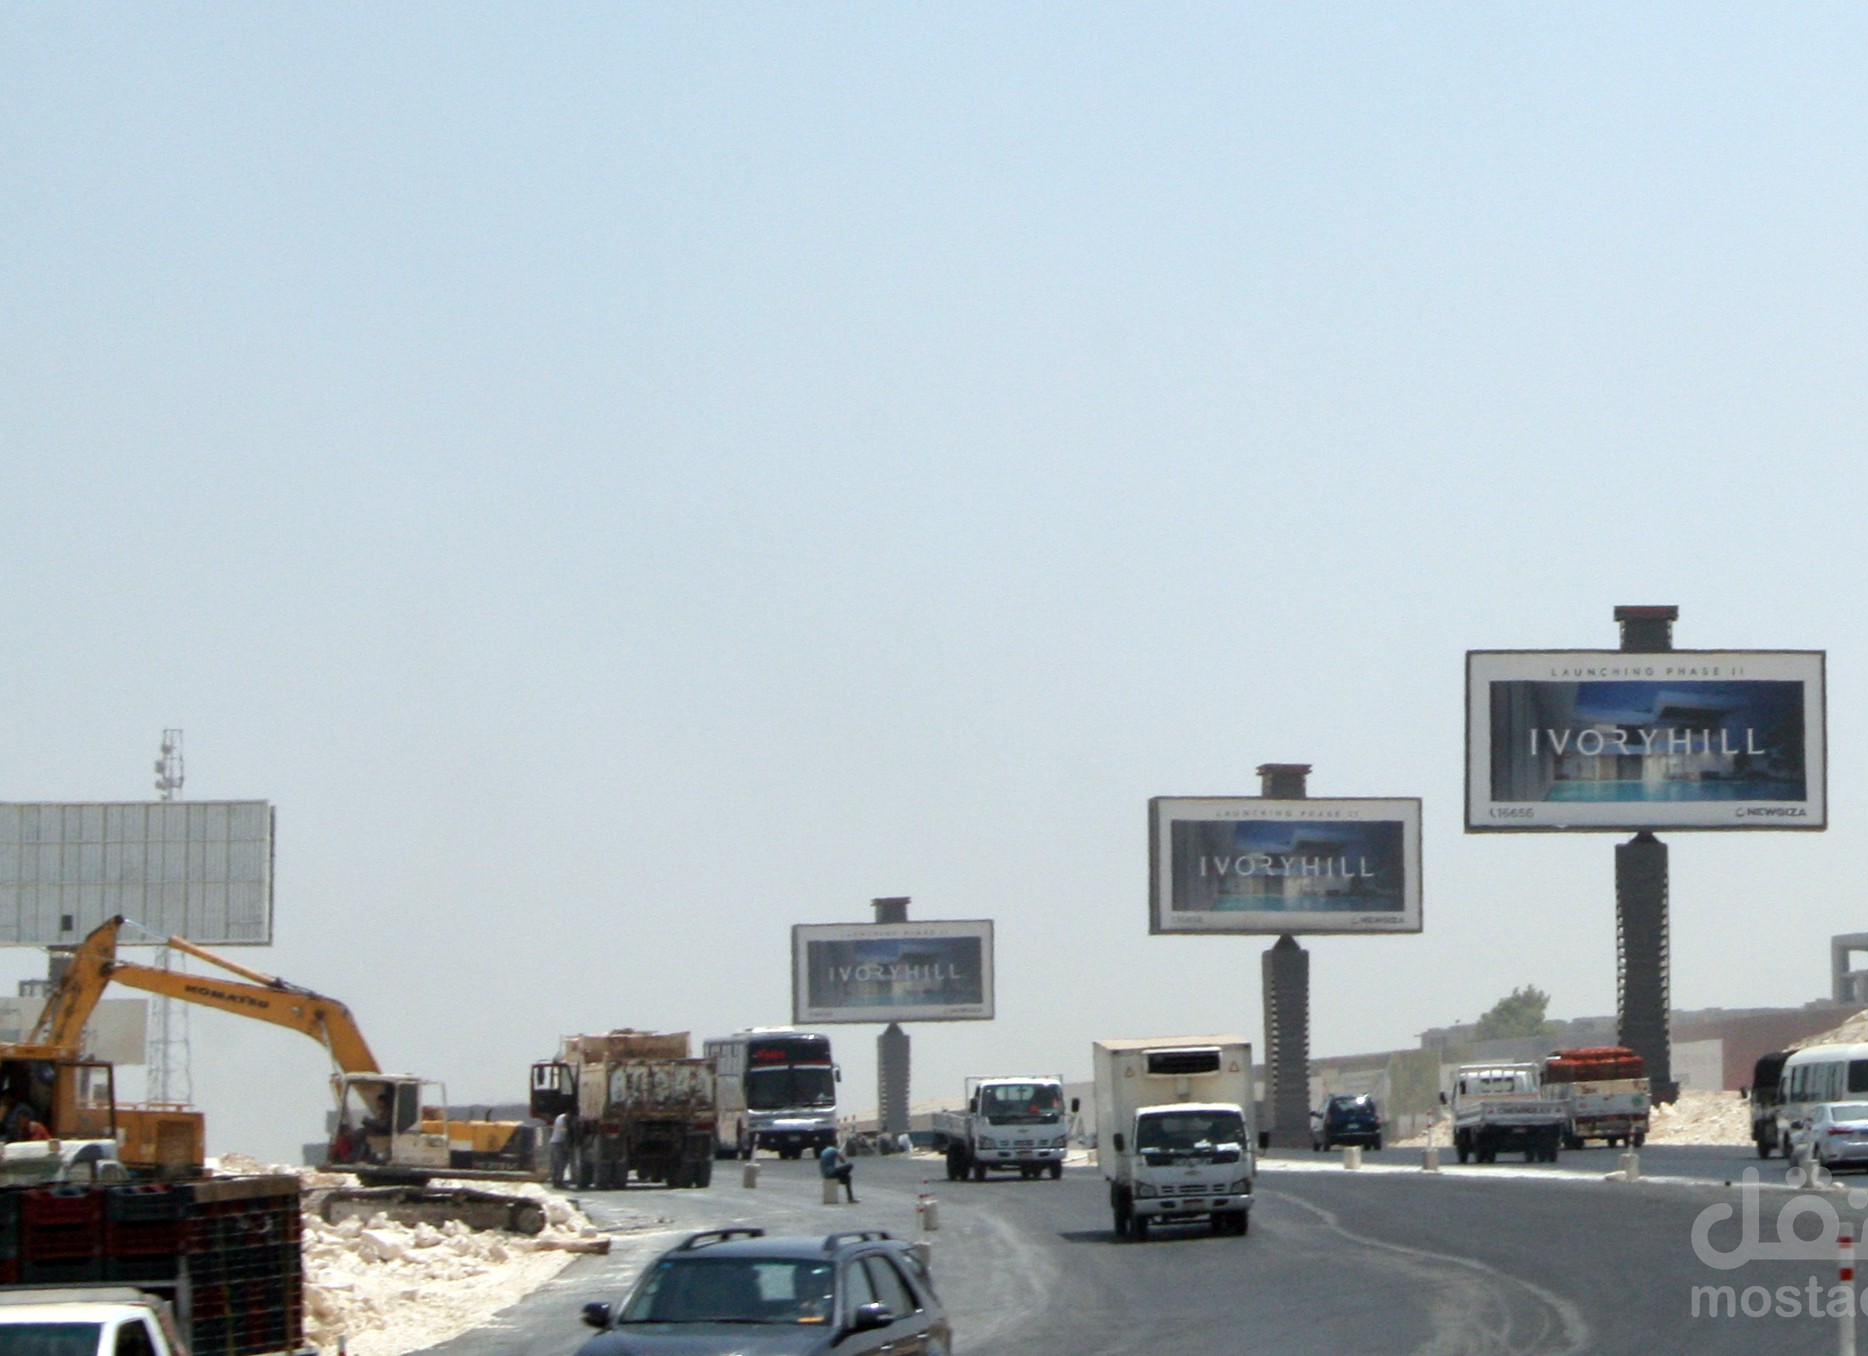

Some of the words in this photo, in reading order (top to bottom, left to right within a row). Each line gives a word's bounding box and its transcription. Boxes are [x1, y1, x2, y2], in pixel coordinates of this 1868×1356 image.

[1550, 667, 1655, 677] LAUNCHING
[1666, 666, 1720, 676] PHASE
[1529, 727, 1766, 756] IVORYHILL
[1200, 855, 1375, 877] IVORYHILL
[828, 963, 962, 982] IVORYHILL
[184, 984, 270, 1009] KOMATSU
